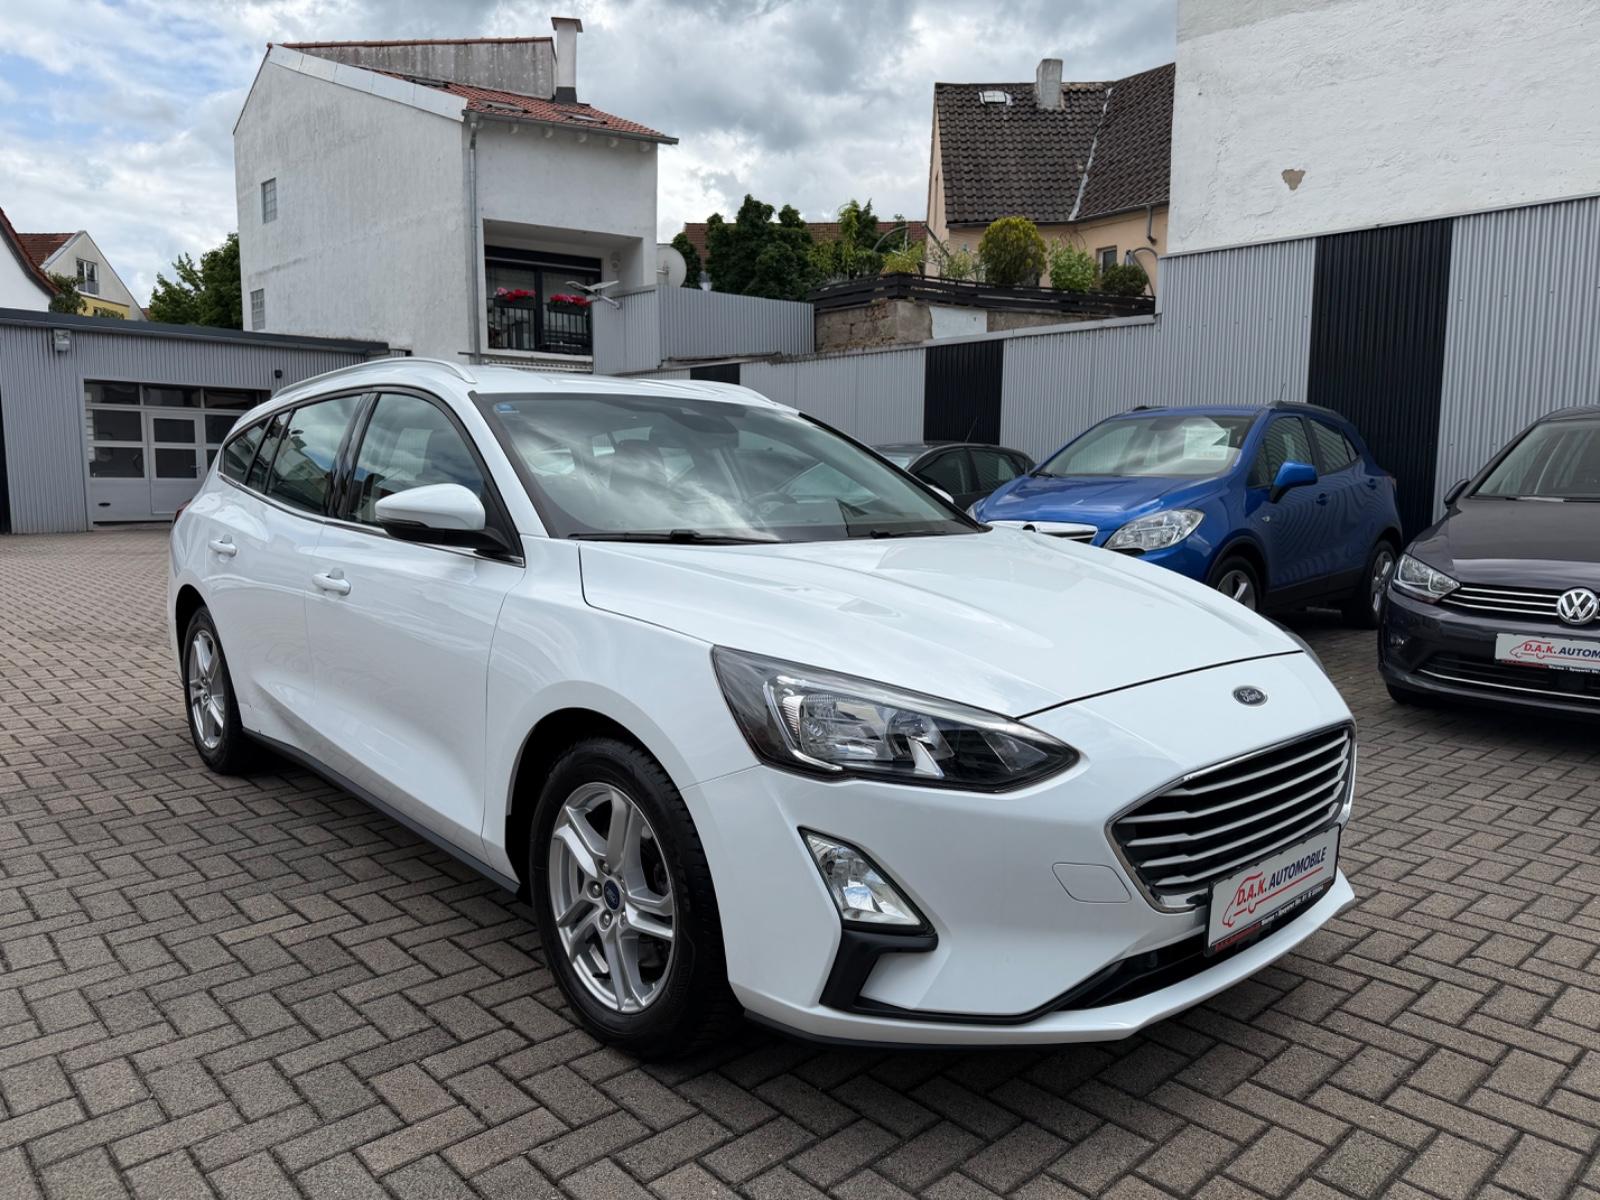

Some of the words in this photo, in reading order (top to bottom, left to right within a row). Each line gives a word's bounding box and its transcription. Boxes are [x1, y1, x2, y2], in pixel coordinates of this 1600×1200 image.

[1523, 643, 1556, 654] D.A.K.
[1236, 878, 1267, 906] D.A.K.
[1268, 846, 1327, 890] AUTOMOBILE
